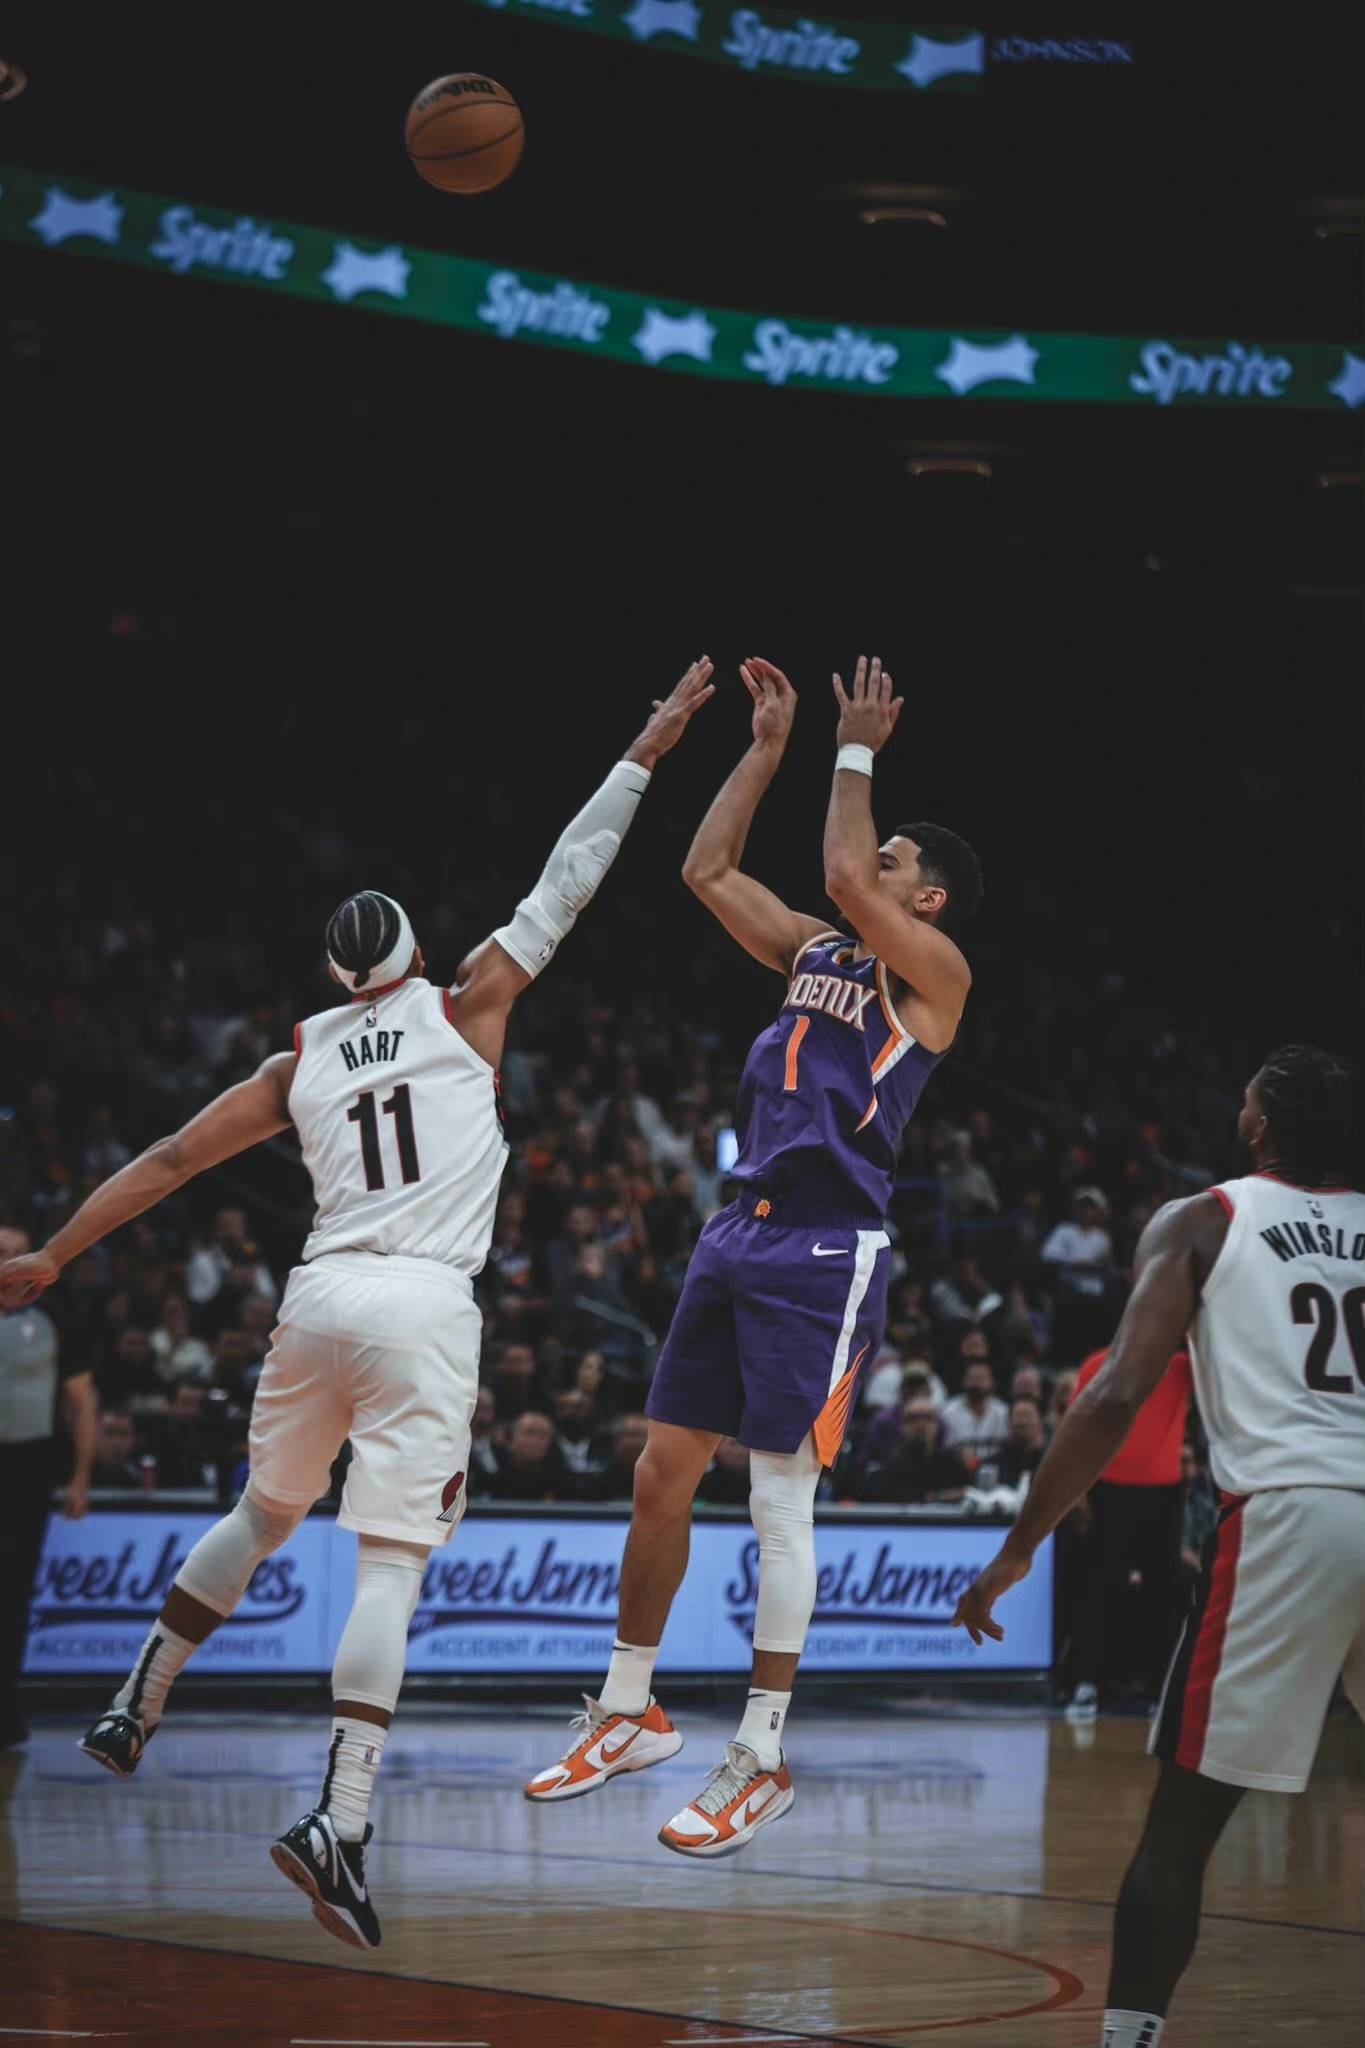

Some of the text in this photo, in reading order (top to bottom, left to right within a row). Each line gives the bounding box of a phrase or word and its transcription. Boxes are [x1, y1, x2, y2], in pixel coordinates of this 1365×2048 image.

[720, 8, 861, 75] Sprite
[149, 204, 295, 281] Sprite
[477, 269, 611, 343] Sprite
[743, 318, 900, 386] Sprite
[1129, 339, 1293, 406] Sprite
[783, 974, 878, 1032] OENIX
[339, 1031, 405, 1072] HART
[784, 1014, 811, 1093] 1
[347, 1083, 421, 1192] 11
[131, 1535, 296, 1602] Jes
[421, 1538, 617, 1605] weet Jam
[726, 1540, 855, 1605] Set
[35, 1637, 287, 1659] ACCIDEN ORNEYS
[430, 1638, 613, 1658] ACCIDENT ATTORN
[801, 1637, 977, 1659] CIDENT ATTORNEYS
